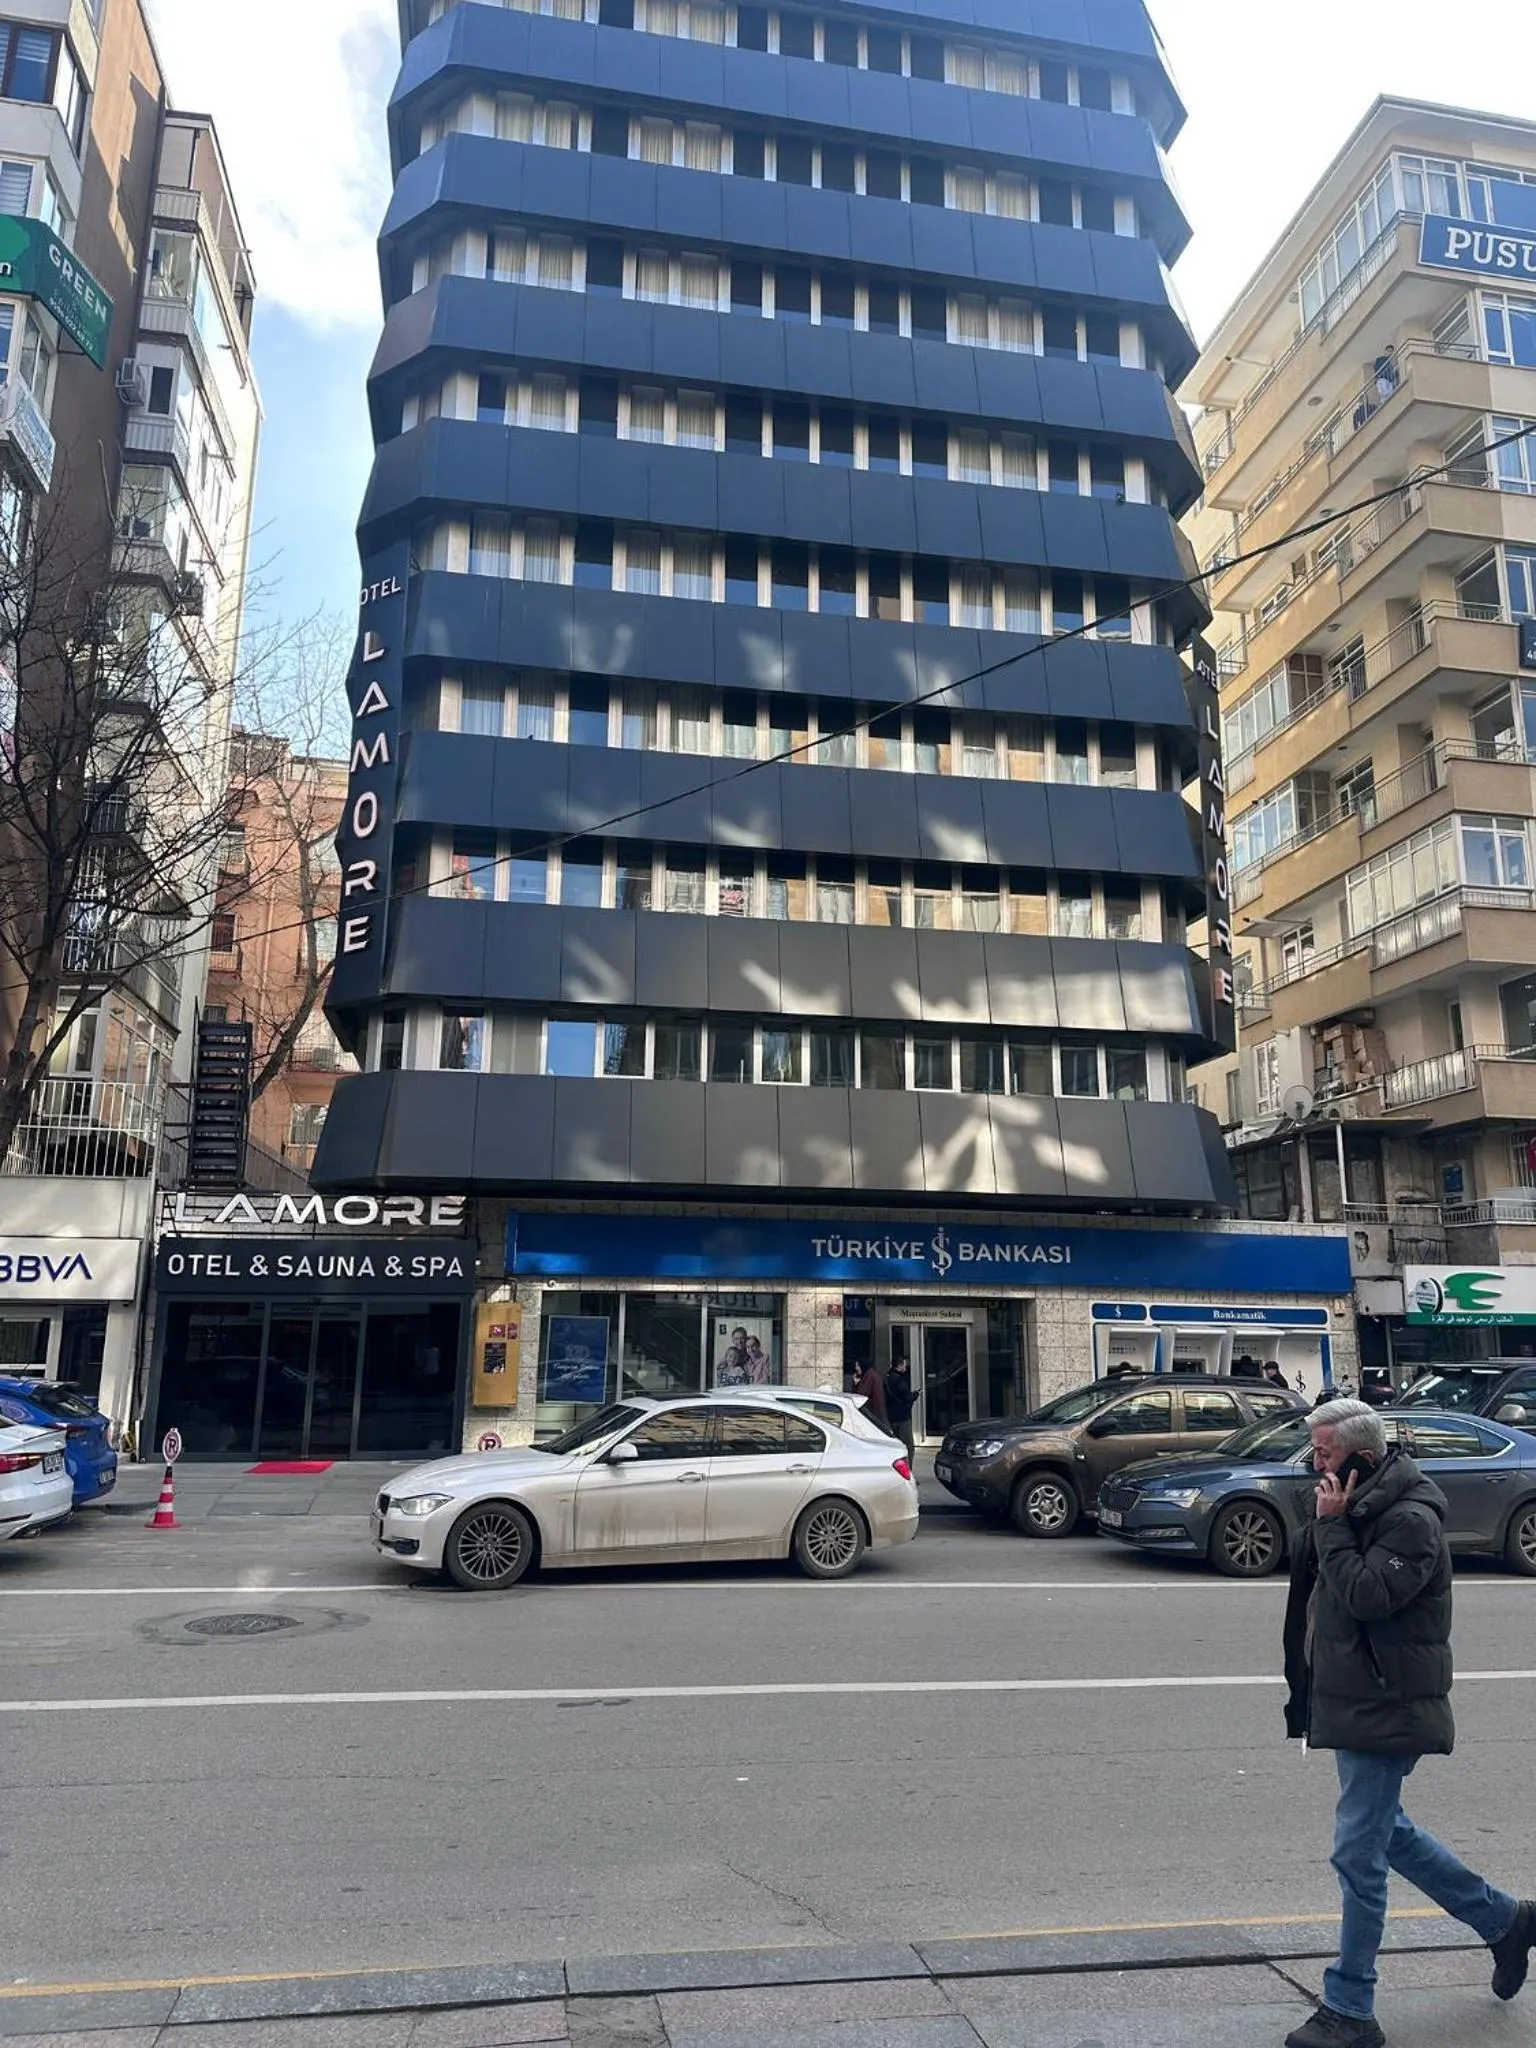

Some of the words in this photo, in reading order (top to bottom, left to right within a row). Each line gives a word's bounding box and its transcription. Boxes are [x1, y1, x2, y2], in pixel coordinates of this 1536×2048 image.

[48, 244, 108, 323] GREEN
[343, 630, 390, 953] LAMORE
[174, 1192, 467, 1227] LAMORE
[811, 1234, 925, 1260] TÜRKİYE
[958, 1242, 1072, 1264] BANKASI
[168, 1254, 240, 1276] OTEL
[249, 1254, 269, 1276] &
[276, 1255, 376, 1277] SAUNA
[384, 1255, 404, 1277] &
[410, 1256, 464, 1278] SPA
[1213, 1309, 1267, 1321] Bankamatik
